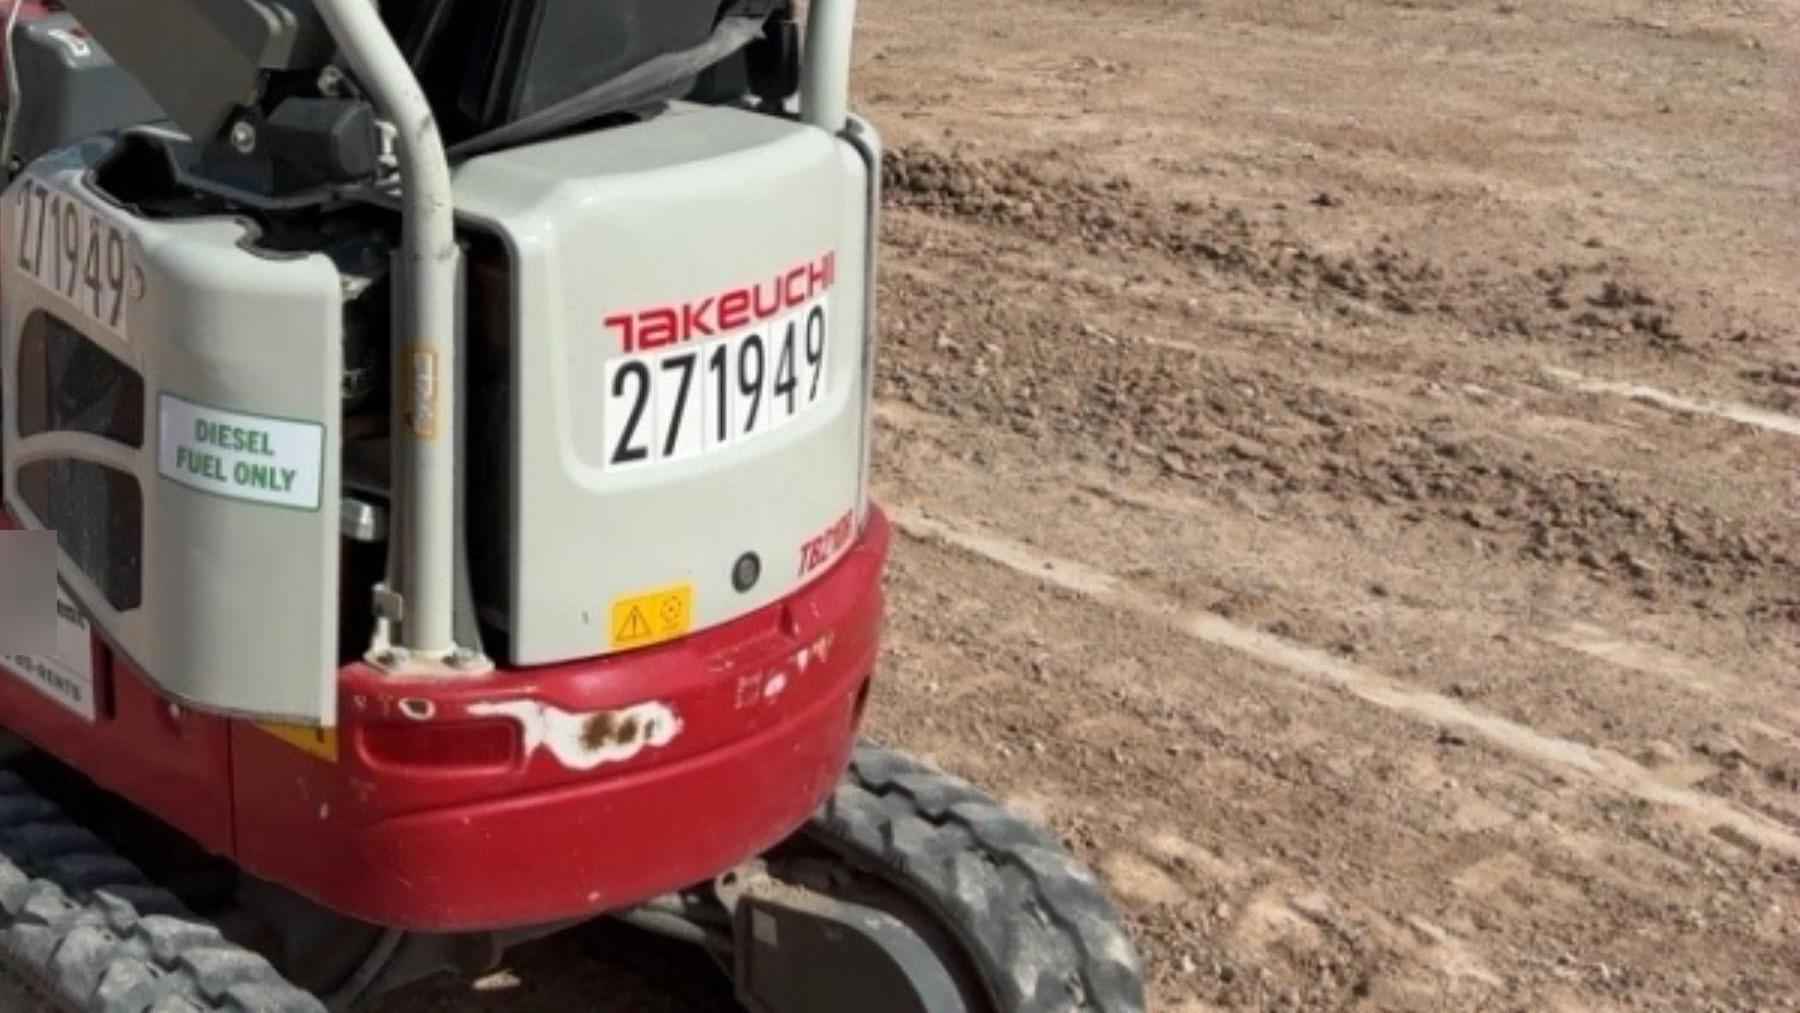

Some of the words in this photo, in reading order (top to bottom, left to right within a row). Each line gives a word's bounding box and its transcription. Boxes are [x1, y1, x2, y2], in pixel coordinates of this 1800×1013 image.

[18, 178, 125, 327] 271949
[610, 304, 826, 465] 271949
[176, 445, 227, 482] FUEL
[233, 460, 297, 492] ONLY
[195, 419, 274, 456] DIESEL
